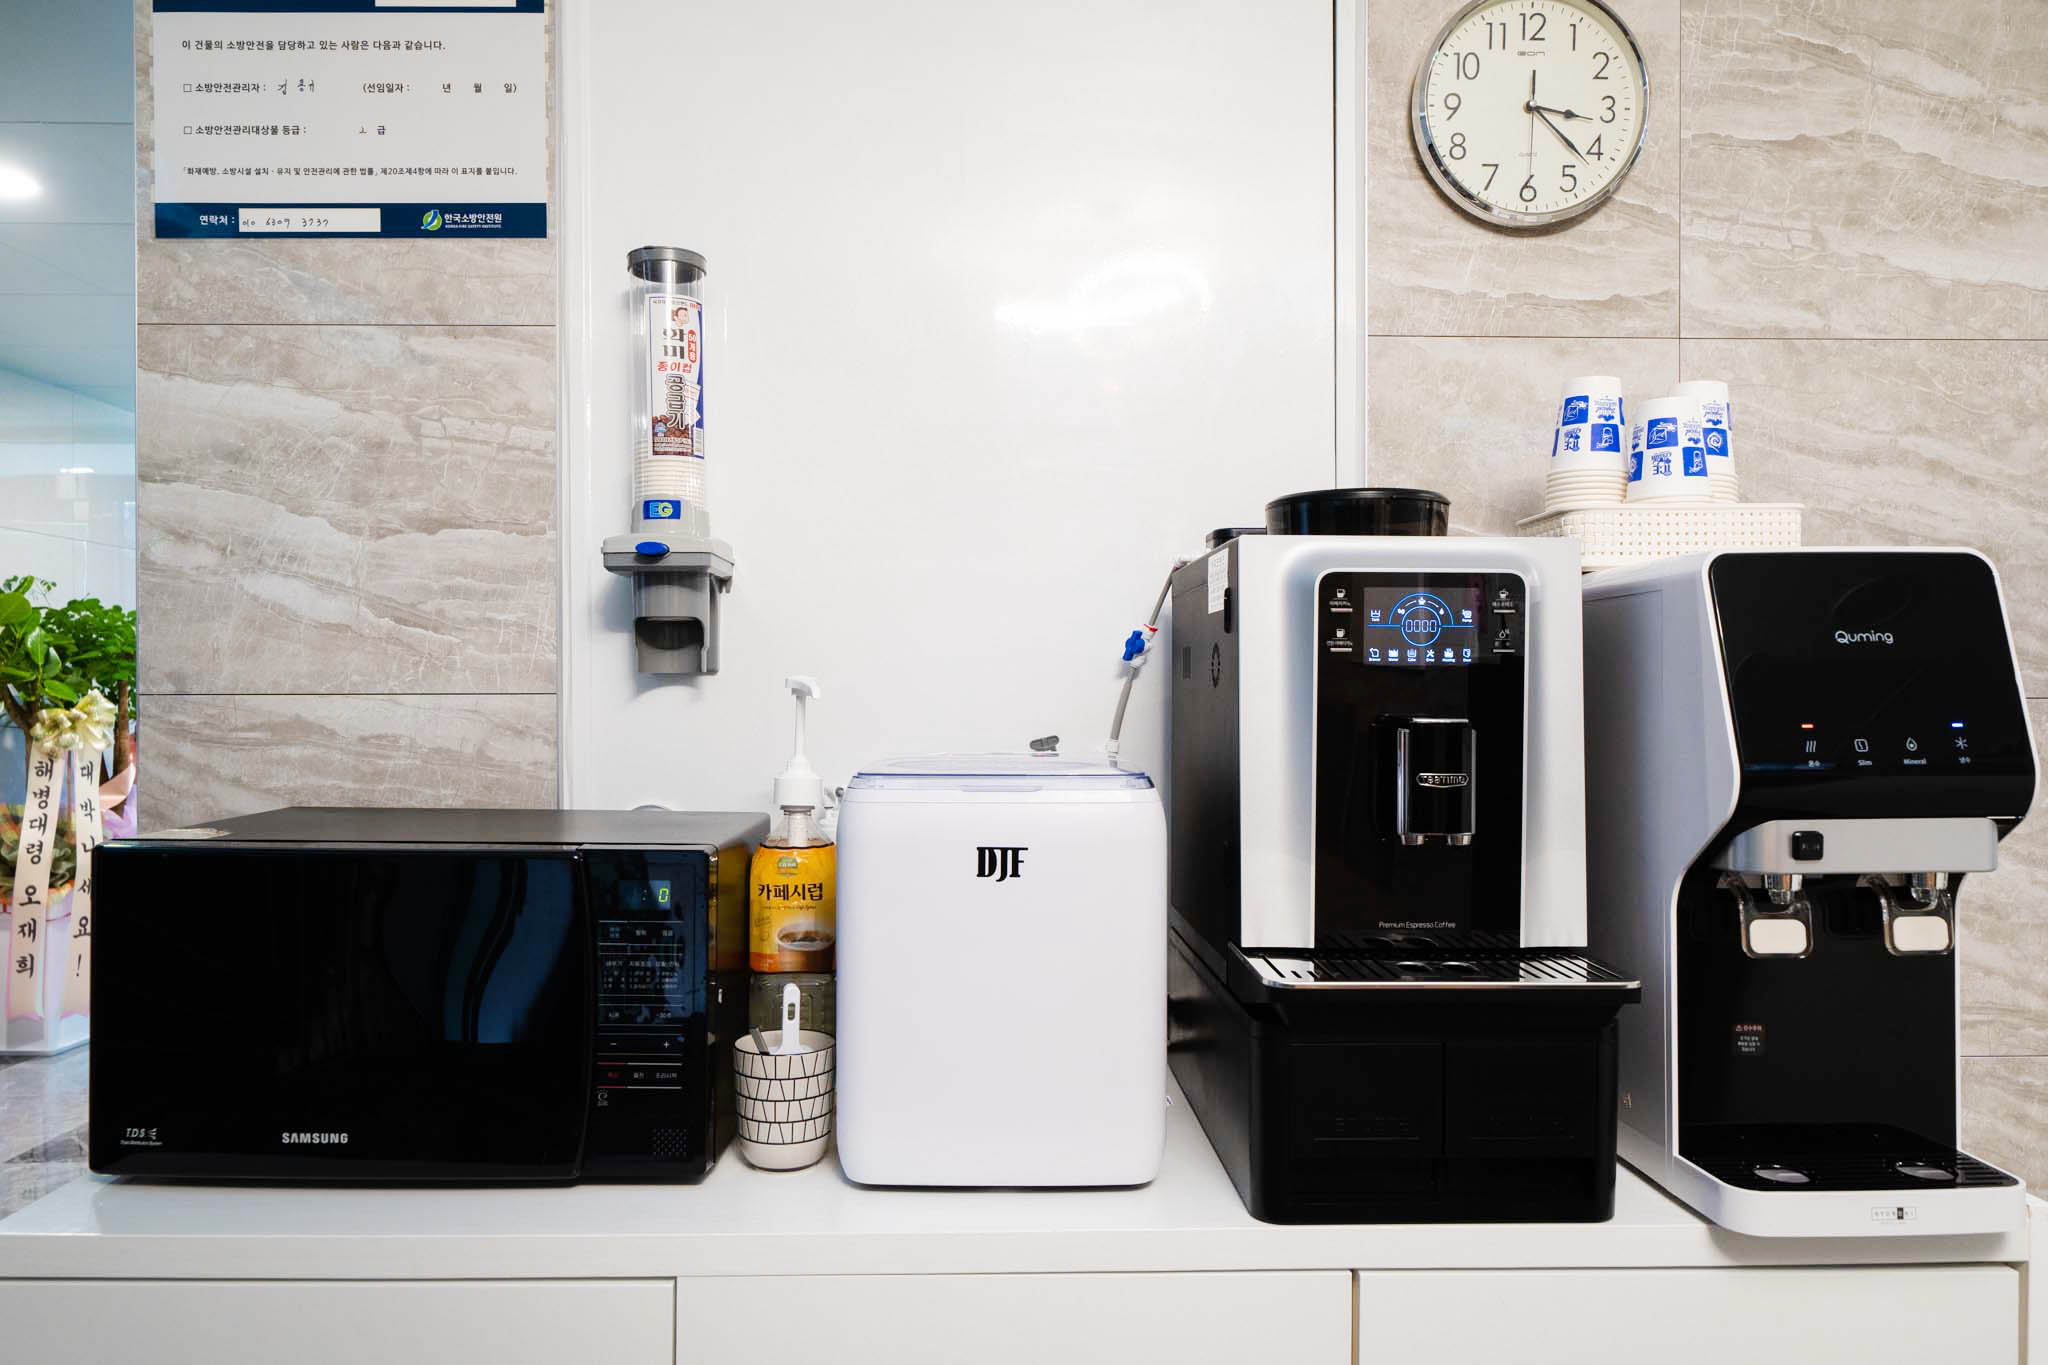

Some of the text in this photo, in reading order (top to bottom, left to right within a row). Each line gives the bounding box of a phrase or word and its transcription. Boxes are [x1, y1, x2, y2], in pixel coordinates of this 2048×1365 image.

[1519, 12, 1547, 41] 12
[181, 40, 447, 51] 이 건물의 소방안전을 담당하고 있는 사람은 다음과 같습니다.
[1486, 22, 1506, 51] 11
[1569, 23, 1577, 51] 1
[1453, 51, 1481, 81] 10
[1592, 51, 1610, 80] 2
[195, 83, 260, 93] 소방안전관리자
[362, 82, 404, 94] (선임일자
[442, 83, 452, 93] 년
[473, 83, 483, 93] 월
[503, 83, 518, 94] 일)
[1443, 92, 1462, 121] 9
[1599, 95, 1616, 124] 3
[195, 125, 279, 136] 소방안전관리대상물
[282, 125, 301, 136] 등급
[376, 125, 387, 136] 급
[1449, 132, 1467, 160] 8
[1586, 133, 1604, 161] 4
[221, 167, 252, 176] 소방시설
[254, 167, 269, 176] 설치
[276, 167, 292, 176] 유지
[293, 167, 301, 176] 및
[303, 167, 341, 176] 안전관리에
[342, 167, 357, 176] 관한
[380, 167, 433, 176] 제20조제4항에
[434, 167, 450, 176] 따라
[451, 167, 459, 176] 이
[461, 167, 483, 176] 표지를
[1481, 163, 1500, 192] 7
[1559, 164, 1577, 193] 5
[1519, 174, 1537, 202] 6
[199, 215, 228, 226] 연락처
[444, 213, 503, 223] 한국소방안전원
[649, 501, 673, 518] EG
[1834, 629, 1894, 645] Quming
[1857, 759, 1873, 767] Slim
[1903, 757, 1927, 765] Mineral
[15, 758, 55, 979] 해병대령 오재희
[976, 846, 1029, 882] DJF
[658, 888, 669, 903] 0
[757, 882, 824, 902] 카페시럽
[1378, 920, 1457, 930] Premium Espresso Coffee
[281, 1131, 350, 1145] SAMSUNG
